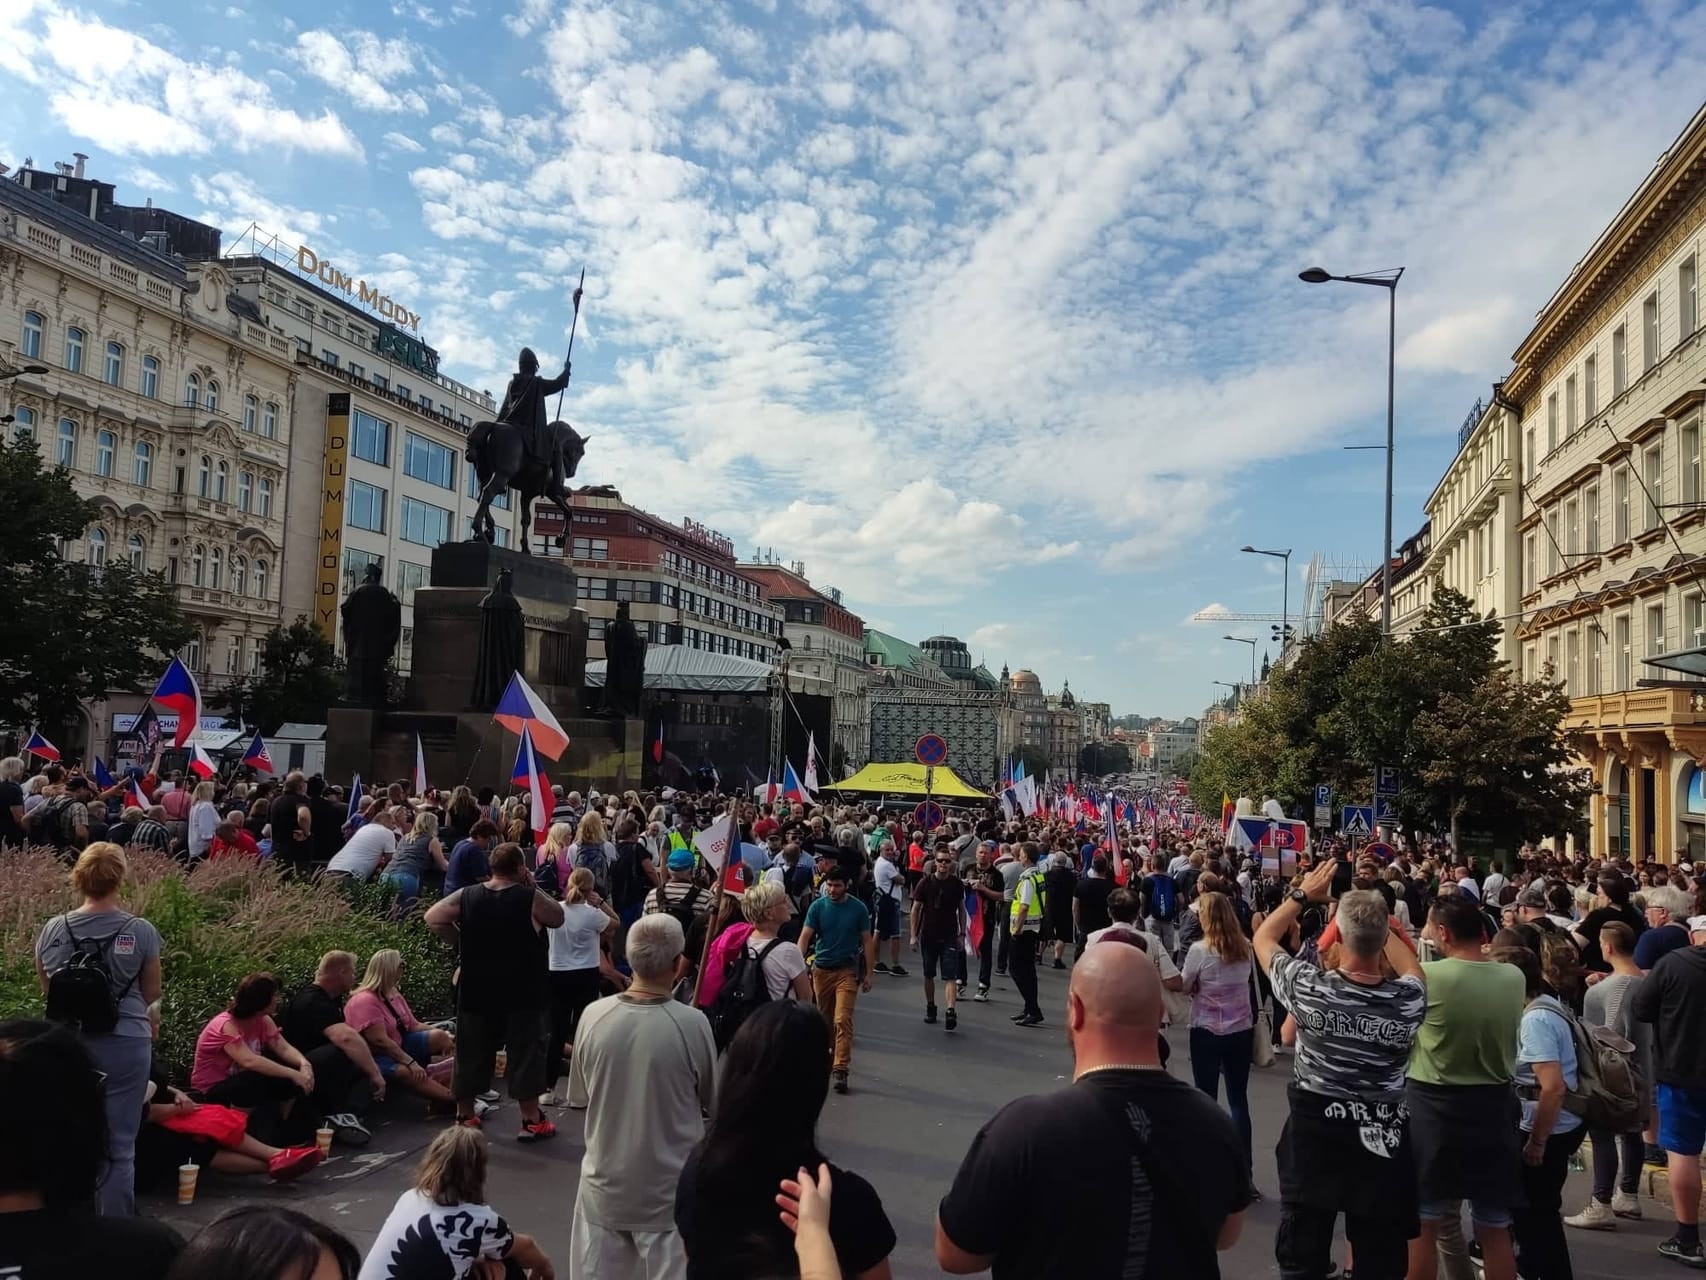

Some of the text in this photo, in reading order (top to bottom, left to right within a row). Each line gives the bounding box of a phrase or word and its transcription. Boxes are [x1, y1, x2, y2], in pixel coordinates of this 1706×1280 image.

[298, 245, 421, 332] DŮM MÓDY
[320, 436, 345, 624] DŮM MÓDY
[1319, 786, 1329, 799] P
